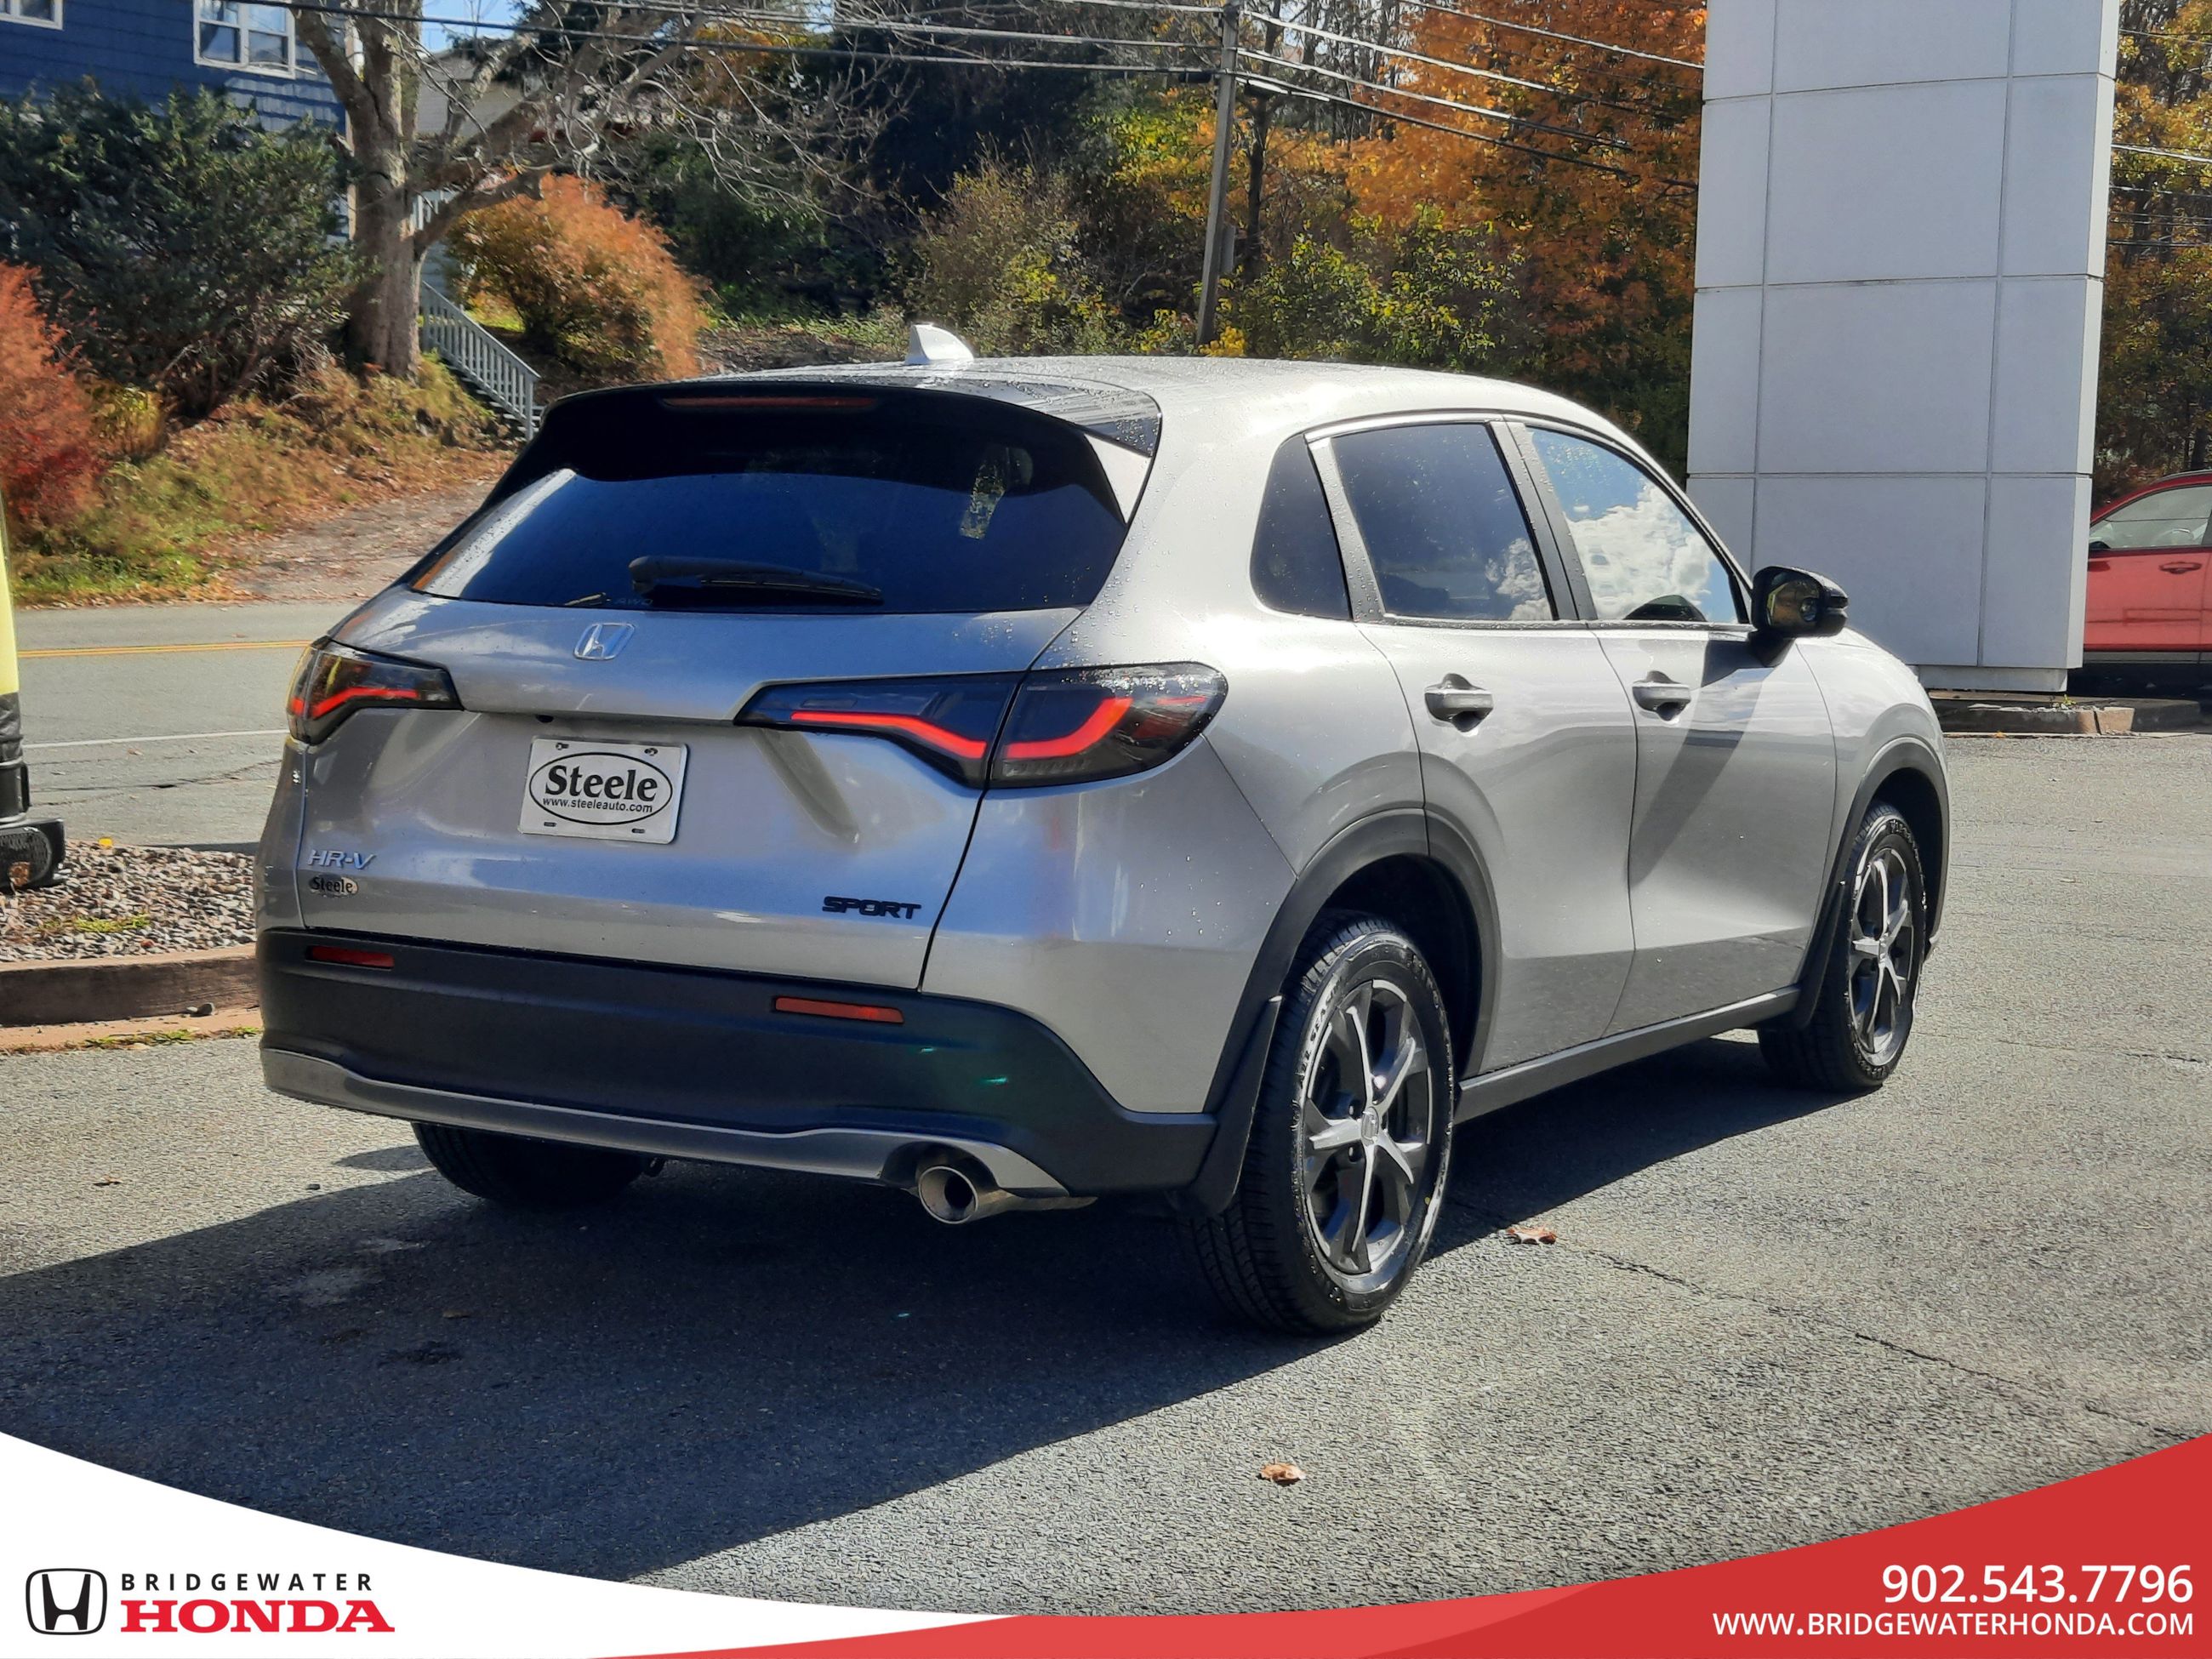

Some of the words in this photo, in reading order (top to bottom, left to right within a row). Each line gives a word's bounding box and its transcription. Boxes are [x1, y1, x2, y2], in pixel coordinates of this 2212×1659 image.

[544, 765, 658, 802] Steele
[542, 796, 653, 813] www.steeleauto.com
[307, 849, 375, 869] HR-V
[309, 876, 353, 893] Steele
[822, 896, 922, 920] SPORT
